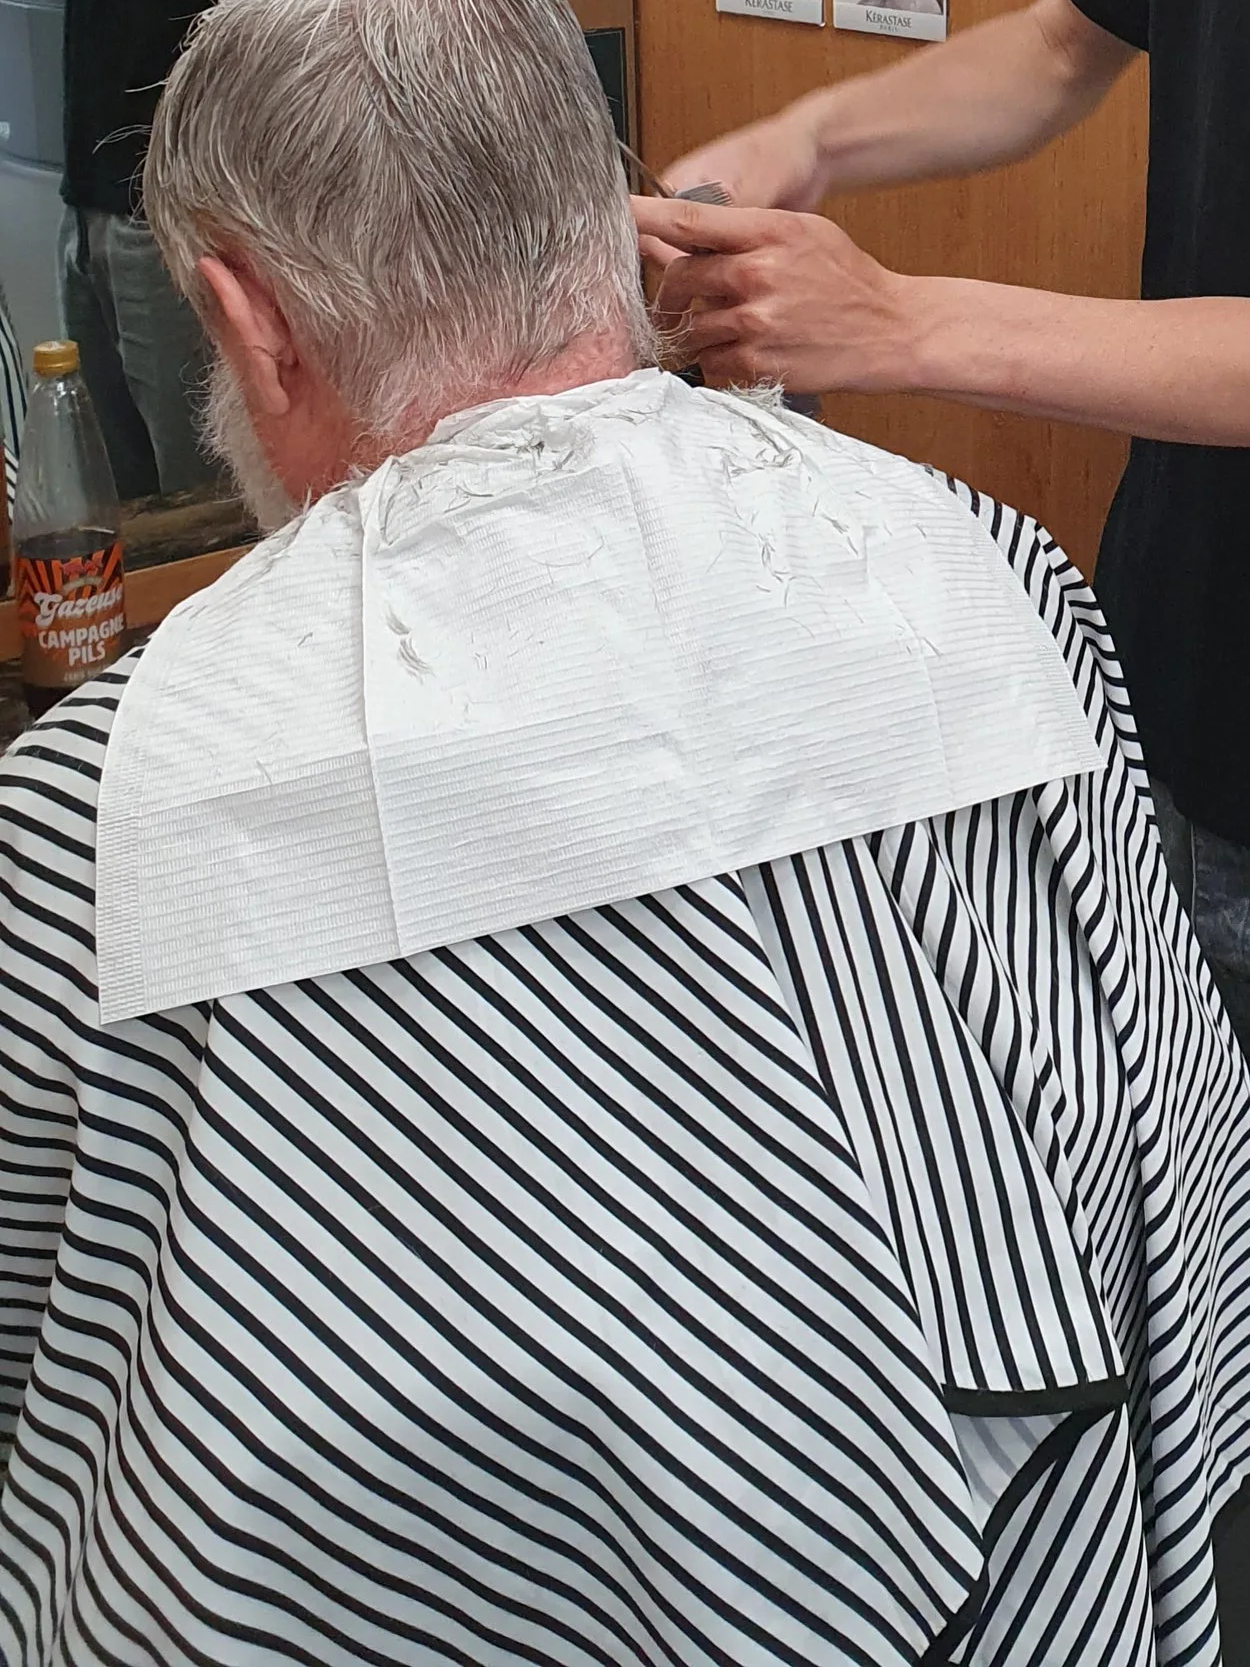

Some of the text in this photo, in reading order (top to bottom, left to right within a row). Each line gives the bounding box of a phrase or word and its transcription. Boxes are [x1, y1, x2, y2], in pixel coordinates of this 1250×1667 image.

[865, 9, 912, 29] KÉRASTASE
[38, 612, 125, 650] CAMPAGNE
[68, 640, 106, 667] PILS
